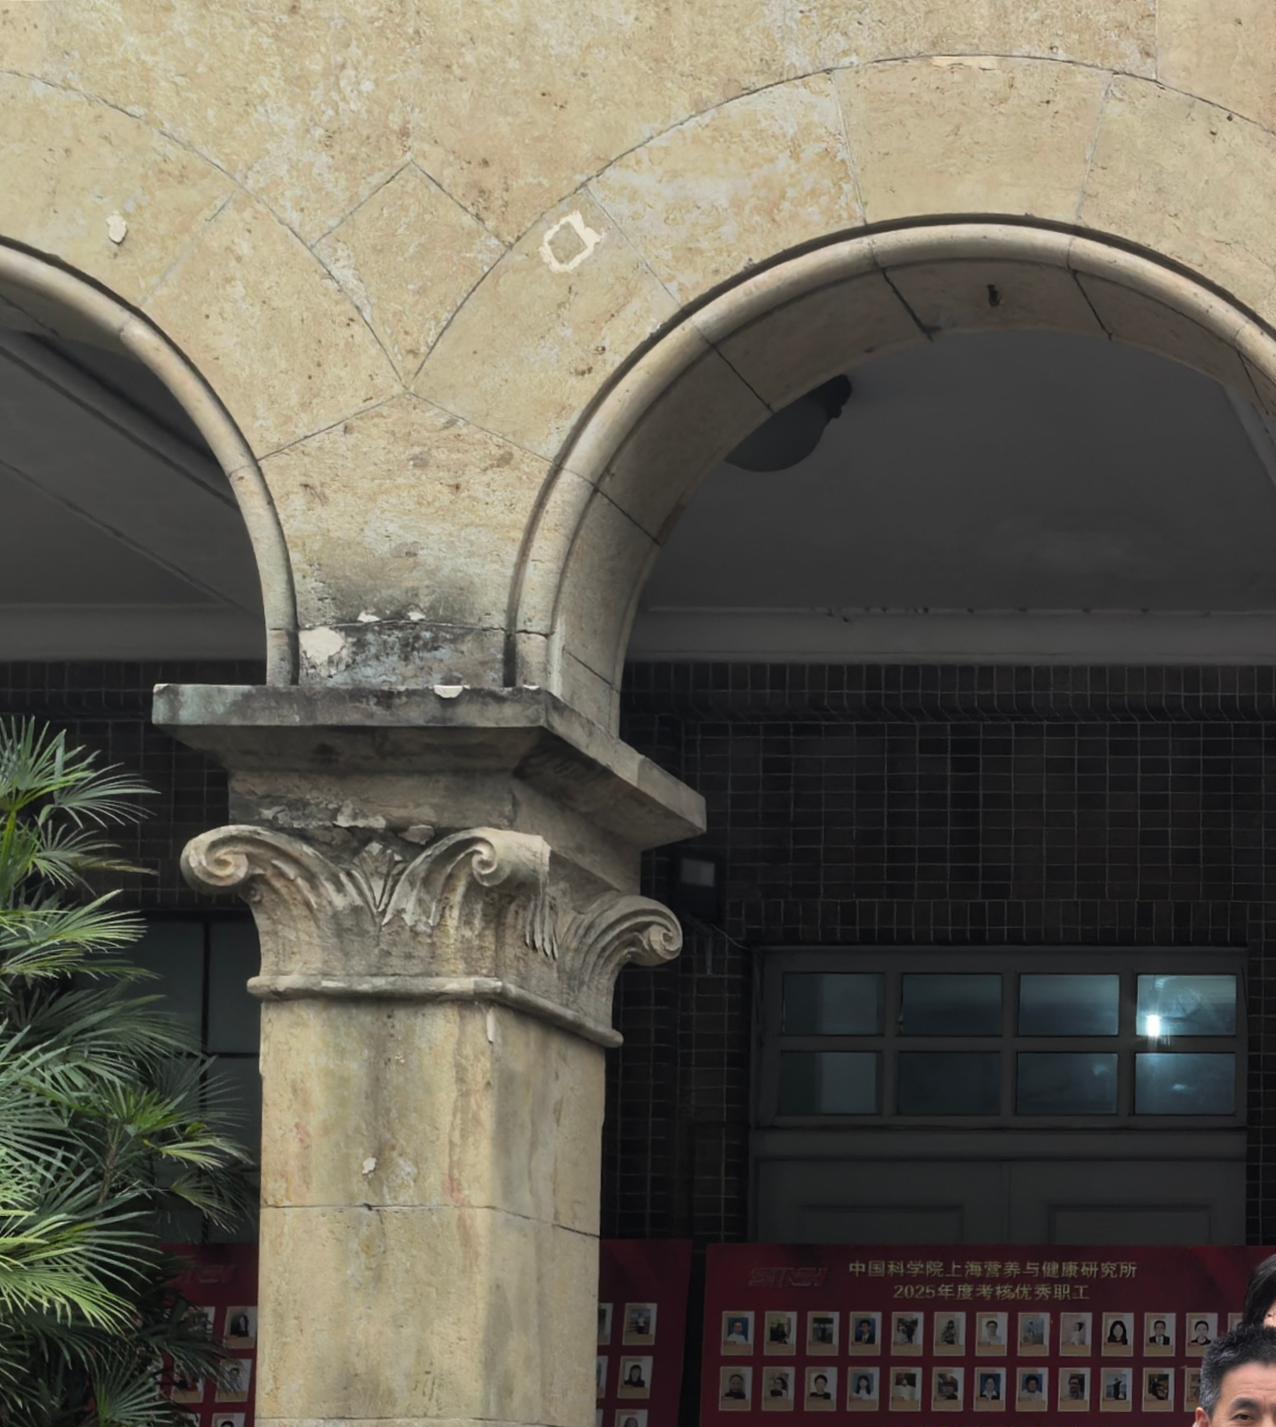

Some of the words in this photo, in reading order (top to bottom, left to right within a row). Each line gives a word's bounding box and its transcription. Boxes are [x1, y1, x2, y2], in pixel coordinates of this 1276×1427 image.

[848, 1259, 1137, 1280] 中国科学院上海营养与健康研究所
[893, 1282, 1090, 1301] 2025年度考核优秀职工
